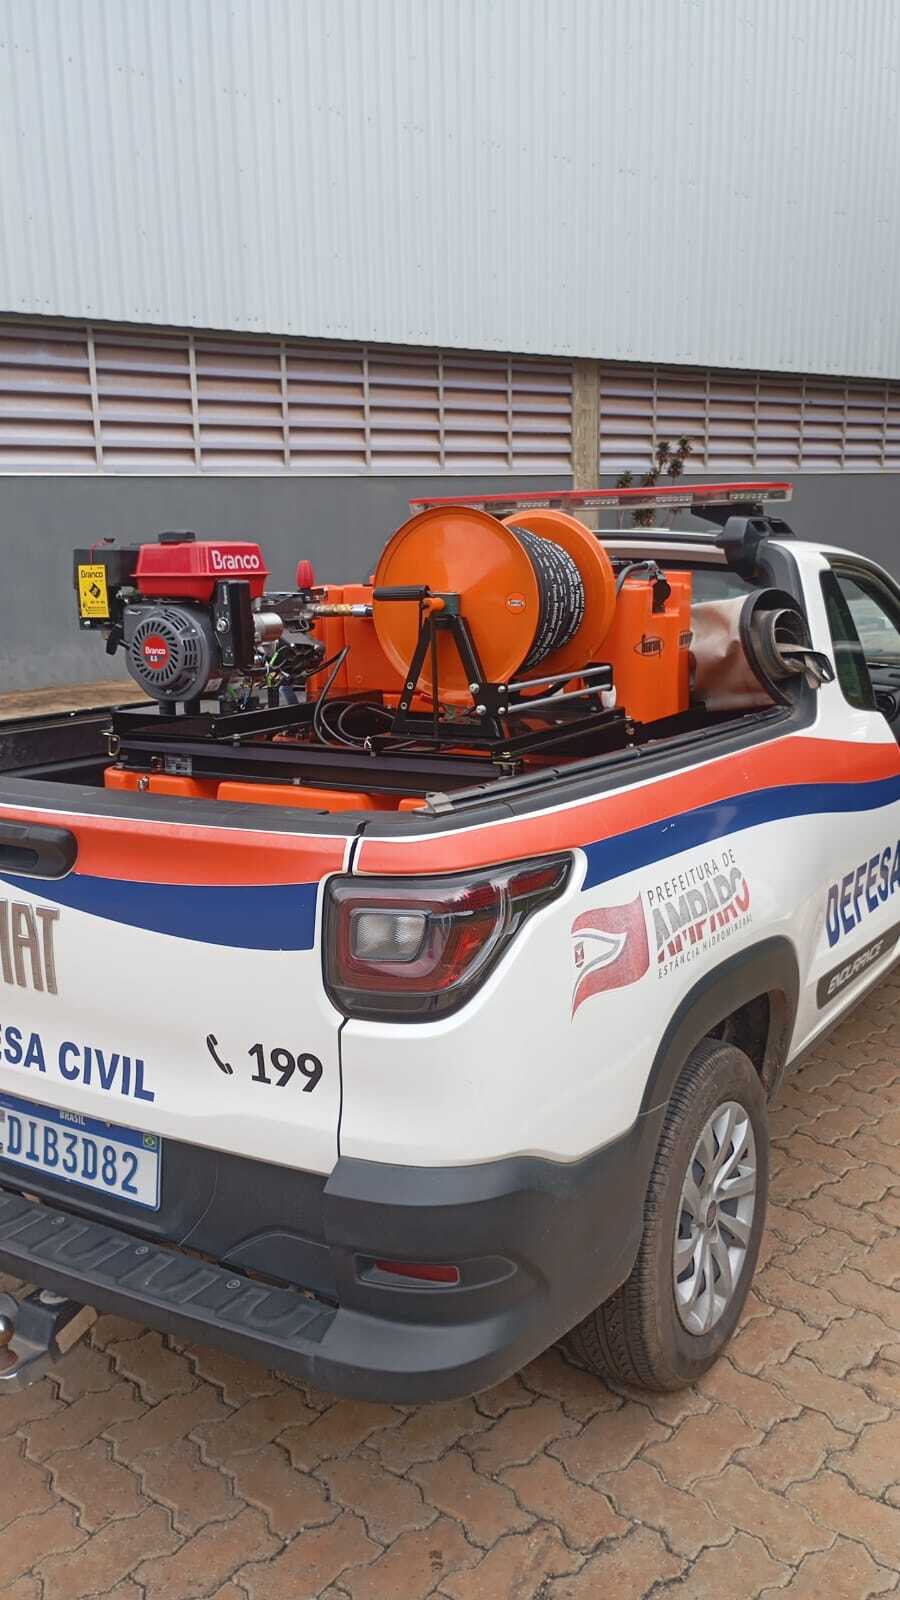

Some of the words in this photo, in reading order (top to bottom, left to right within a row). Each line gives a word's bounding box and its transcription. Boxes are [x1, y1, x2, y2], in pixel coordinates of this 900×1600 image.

[211, 550, 260, 571] Branco
[647, 858, 720, 905] PREFEITURA
[721, 848, 737, 868] DE
[652, 867, 751, 964] AMPARO
[0, 1023, 47, 1074] SA
[58, 1041, 156, 1103] CIVIL
[247, 1043, 324, 1093] 199
[59, 1110, 86, 1127] BRASIL
[7, 1114, 138, 1195] DIB3D82
